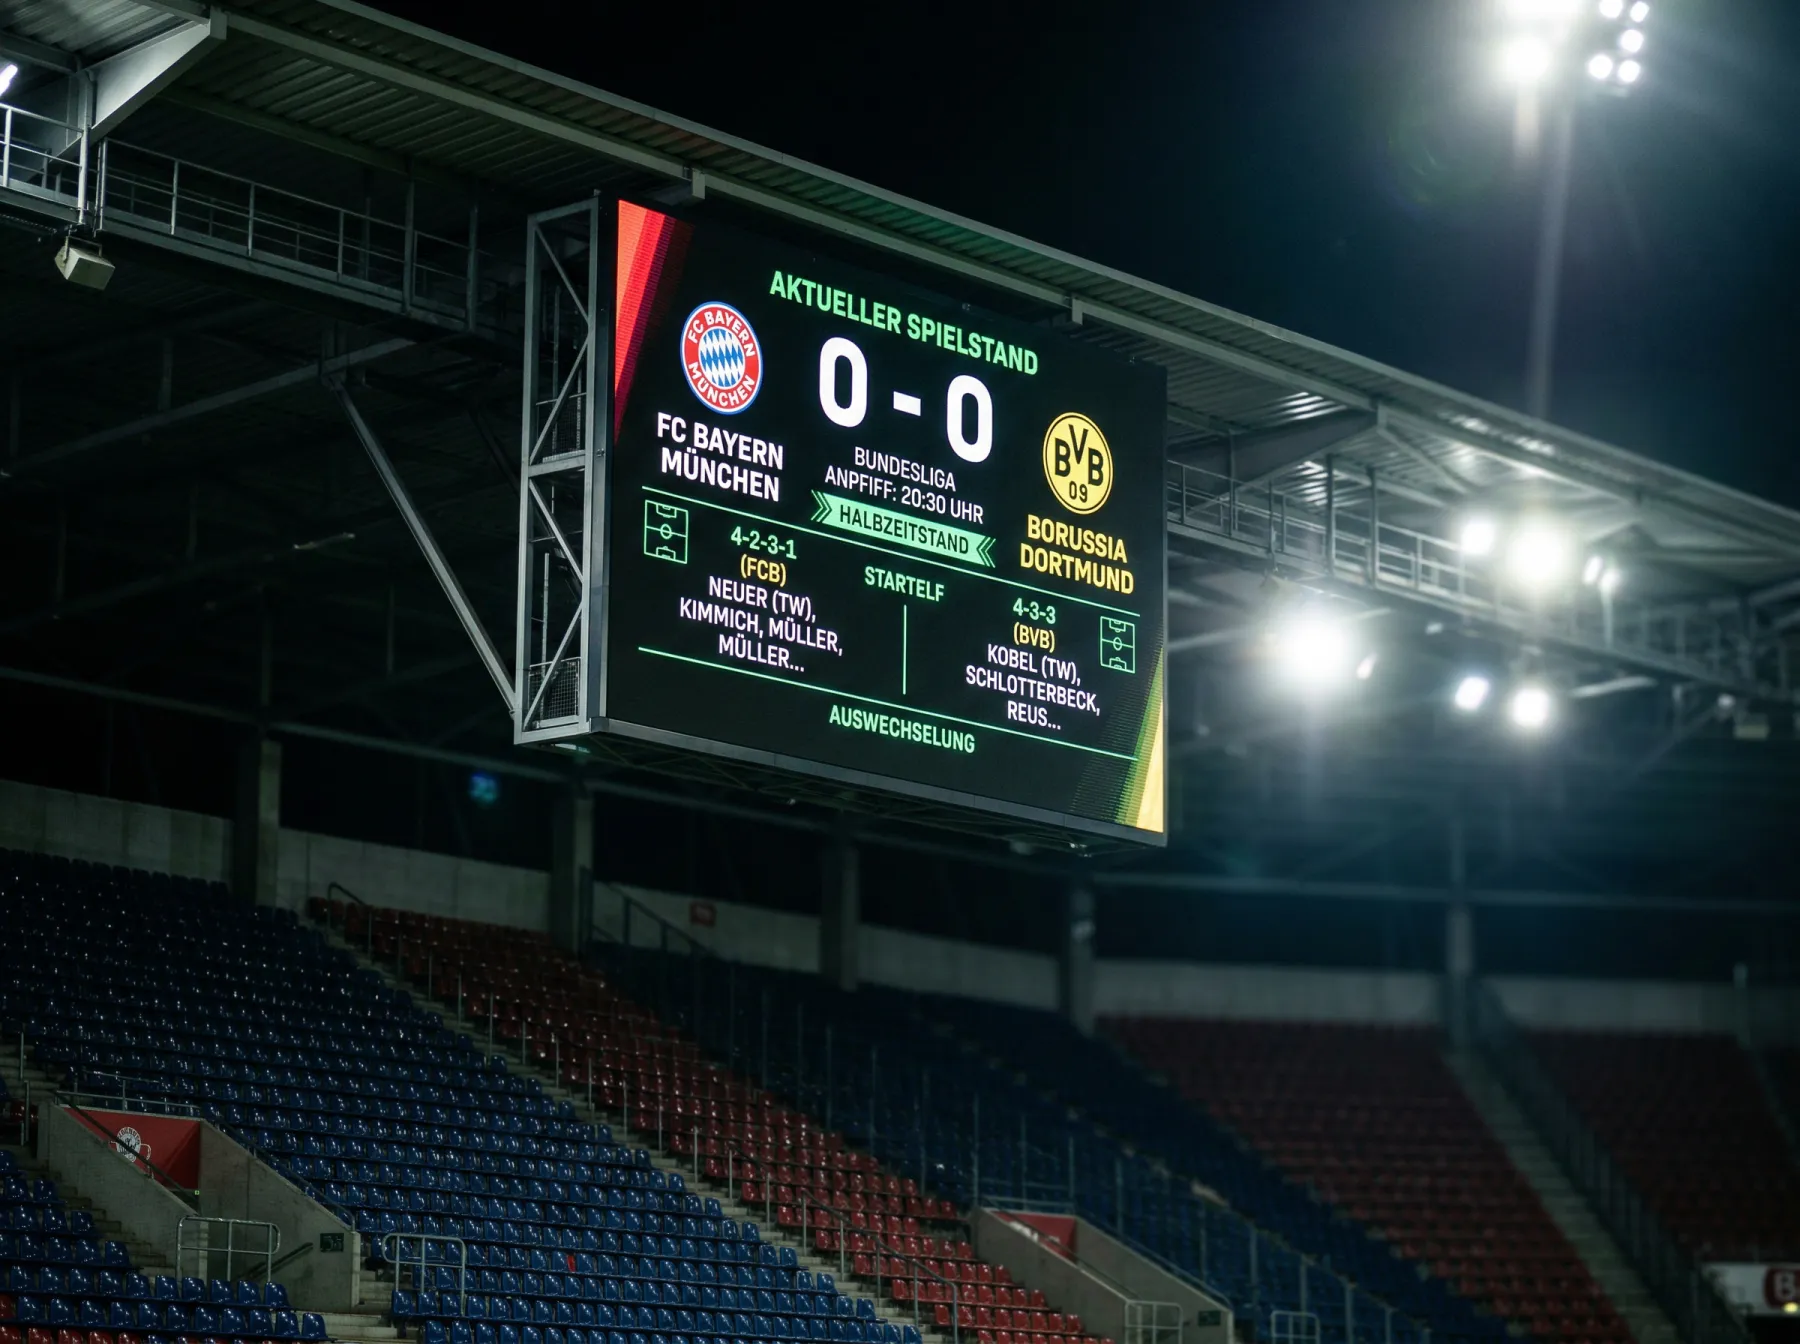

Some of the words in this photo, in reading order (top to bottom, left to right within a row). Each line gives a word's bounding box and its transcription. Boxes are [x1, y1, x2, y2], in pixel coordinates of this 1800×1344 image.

[688, 320, 704, 344] FC
[704, 310, 755, 357] BAYERN
[769, 270, 902, 334] AKTUELLER
[907, 312, 1039, 376] SPIELSTAND
[688, 362, 755, 407] MÜNCHEN
[818, 336, 868, 428] 0
[893, 391, 922, 416] -
[946, 374, 993, 464] 0
[657, 411, 686, 443] FC
[693, 422, 784, 470] BAYERN
[1054, 424, 1104, 487] BVB
[661, 447, 780, 502] MÜNCHEN
[854, 446, 956, 492] BUNDESLIGA
[1068, 481, 1088, 503] 09
[824, 465, 898, 502] ANPFIFF:
[901, 485, 947, 515] 20:30
[950, 497, 984, 525] UHR
[730, 526, 797, 560] 4-2-3-1
[839, 504, 969, 555] HALBZEITSTAND
[1027, 514, 1128, 564] BORUSSIA
[740, 553, 787, 587] (FCB)
[864, 565, 945, 602] STARTELF
[1020, 542, 1134, 595] DORTMUND
[708, 575, 768, 609] NEUER
[772, 589, 817, 623] (TW),
[1012, 597, 1057, 625] 4-3-3
[679, 597, 764, 639] KIMMICH,
[768, 616, 843, 657] MÜLLER,
[1013, 621, 1056, 653] (BVB)
[718, 633, 805, 672] MÜLLER...
[987, 643, 1038, 674] KOBEL
[1041, 655, 1081, 687] (TW),
[965, 665, 1101, 717] SCHLOTTERBECK,
[1007, 700, 1061, 730] REUS...
[829, 704, 976, 754] AUSWECHSELUNG
